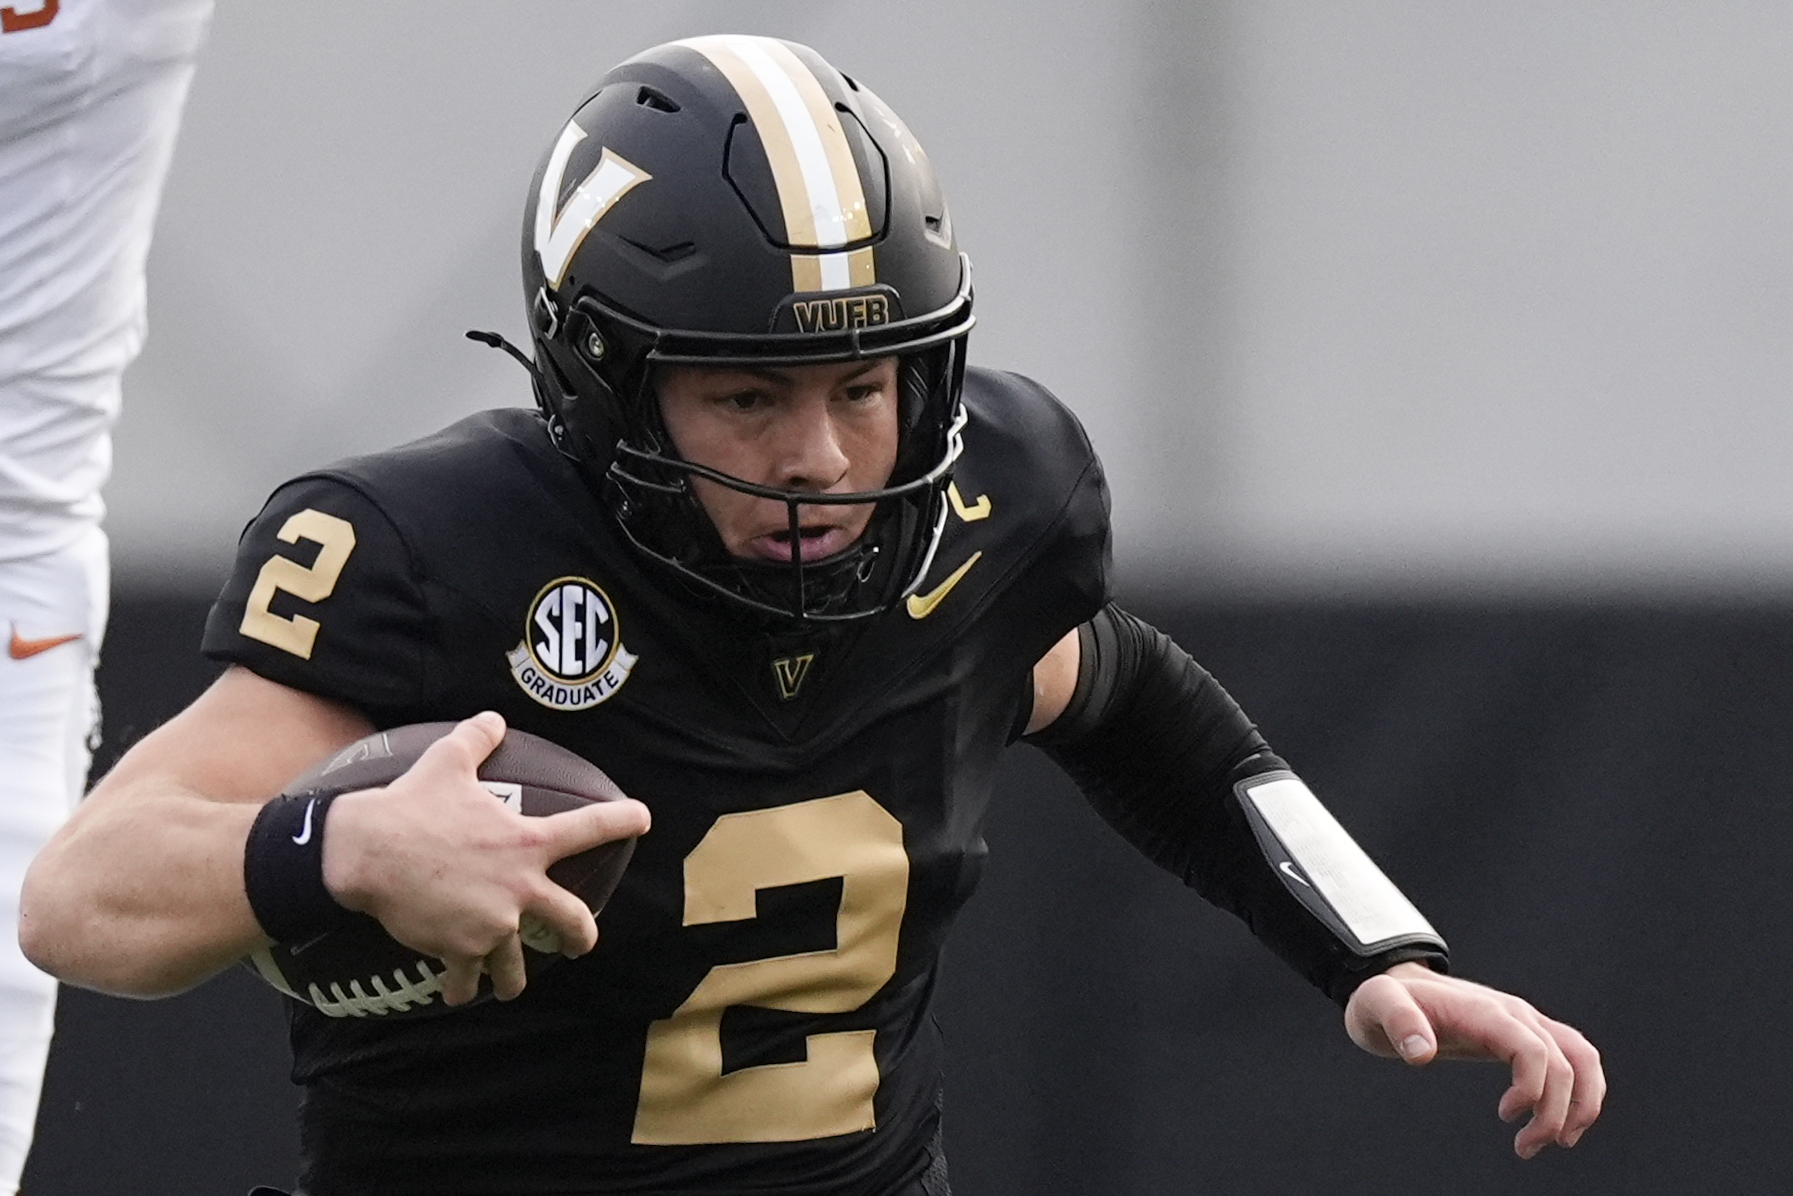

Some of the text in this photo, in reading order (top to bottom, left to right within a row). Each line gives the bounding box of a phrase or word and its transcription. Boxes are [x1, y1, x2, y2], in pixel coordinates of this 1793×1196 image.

[793, 294, 889, 334] VUFB
[239, 508, 357, 660] 2
[534, 584, 609, 676] SEC
[521, 667, 619, 706] GRADUATE
[631, 789, 910, 1146] 2
